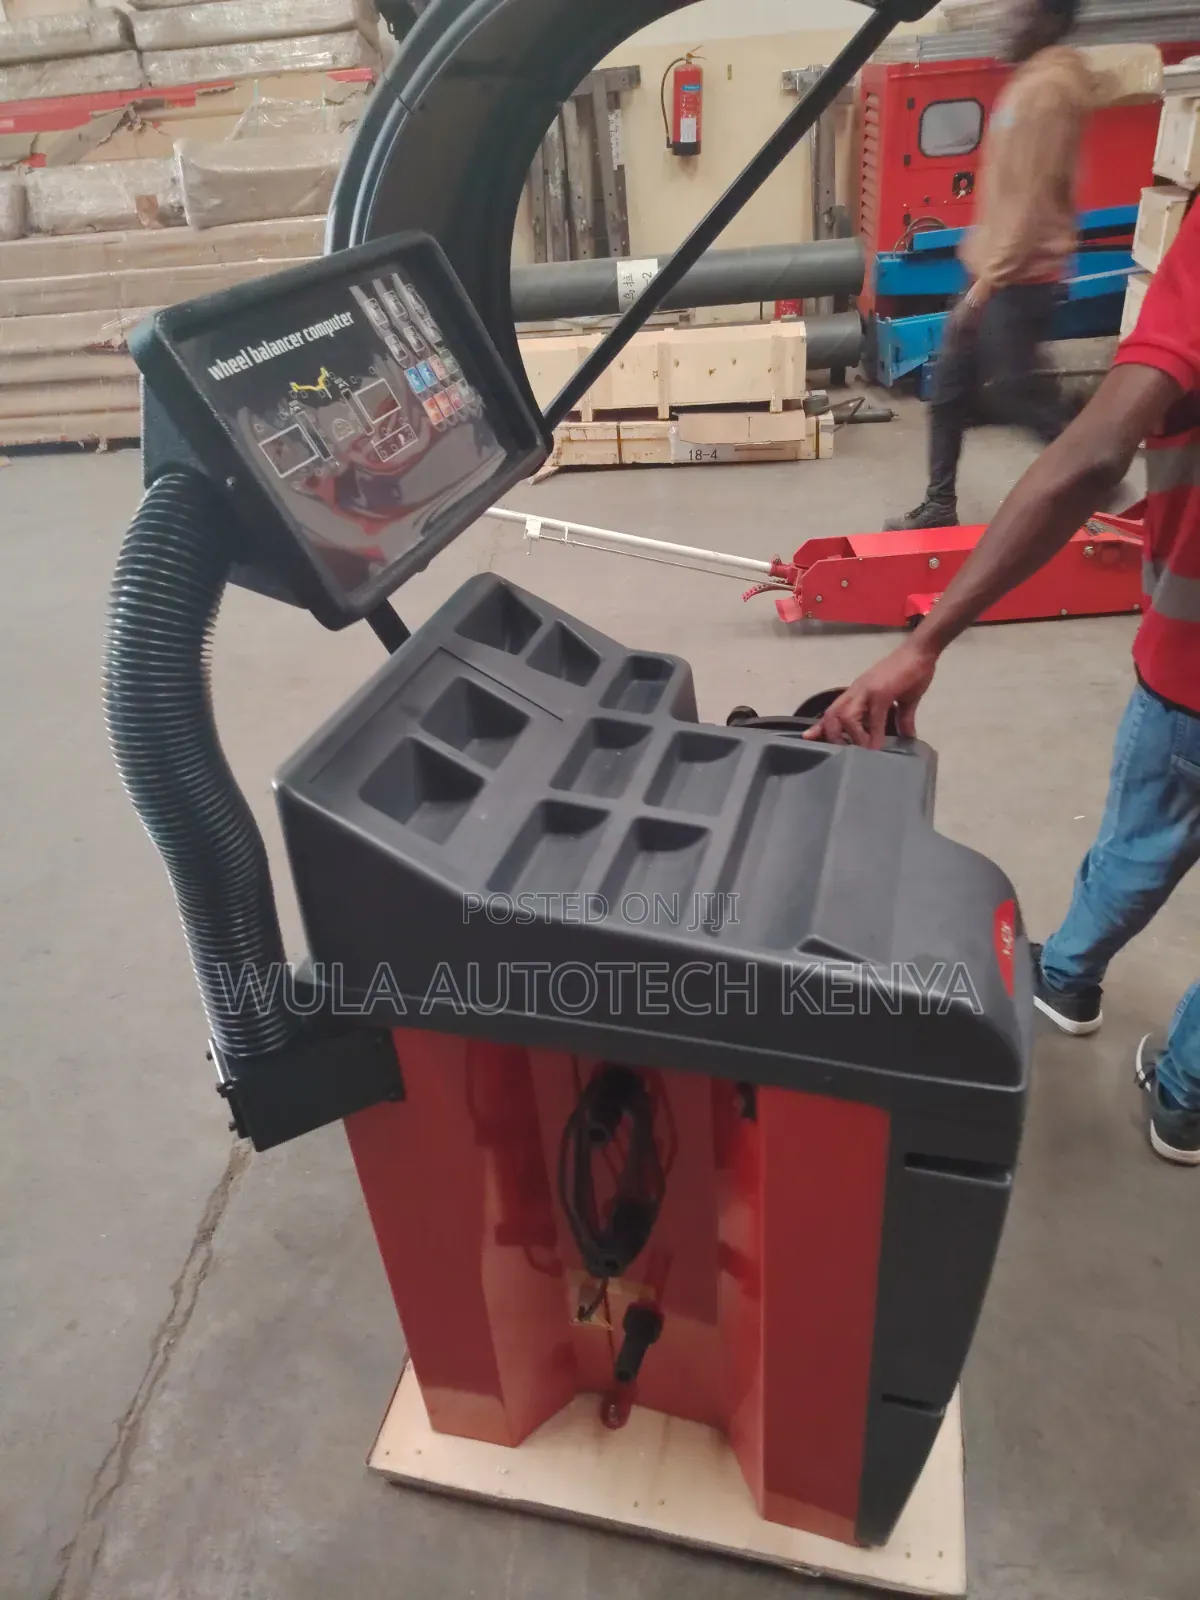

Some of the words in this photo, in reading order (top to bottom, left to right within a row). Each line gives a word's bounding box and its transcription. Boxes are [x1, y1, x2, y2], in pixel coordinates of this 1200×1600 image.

[207, 348, 254, 381] wheel
[246, 331, 305, 364] balancer
[302, 311, 355, 342] computer
[688, 449, 718, 460] 18-4
